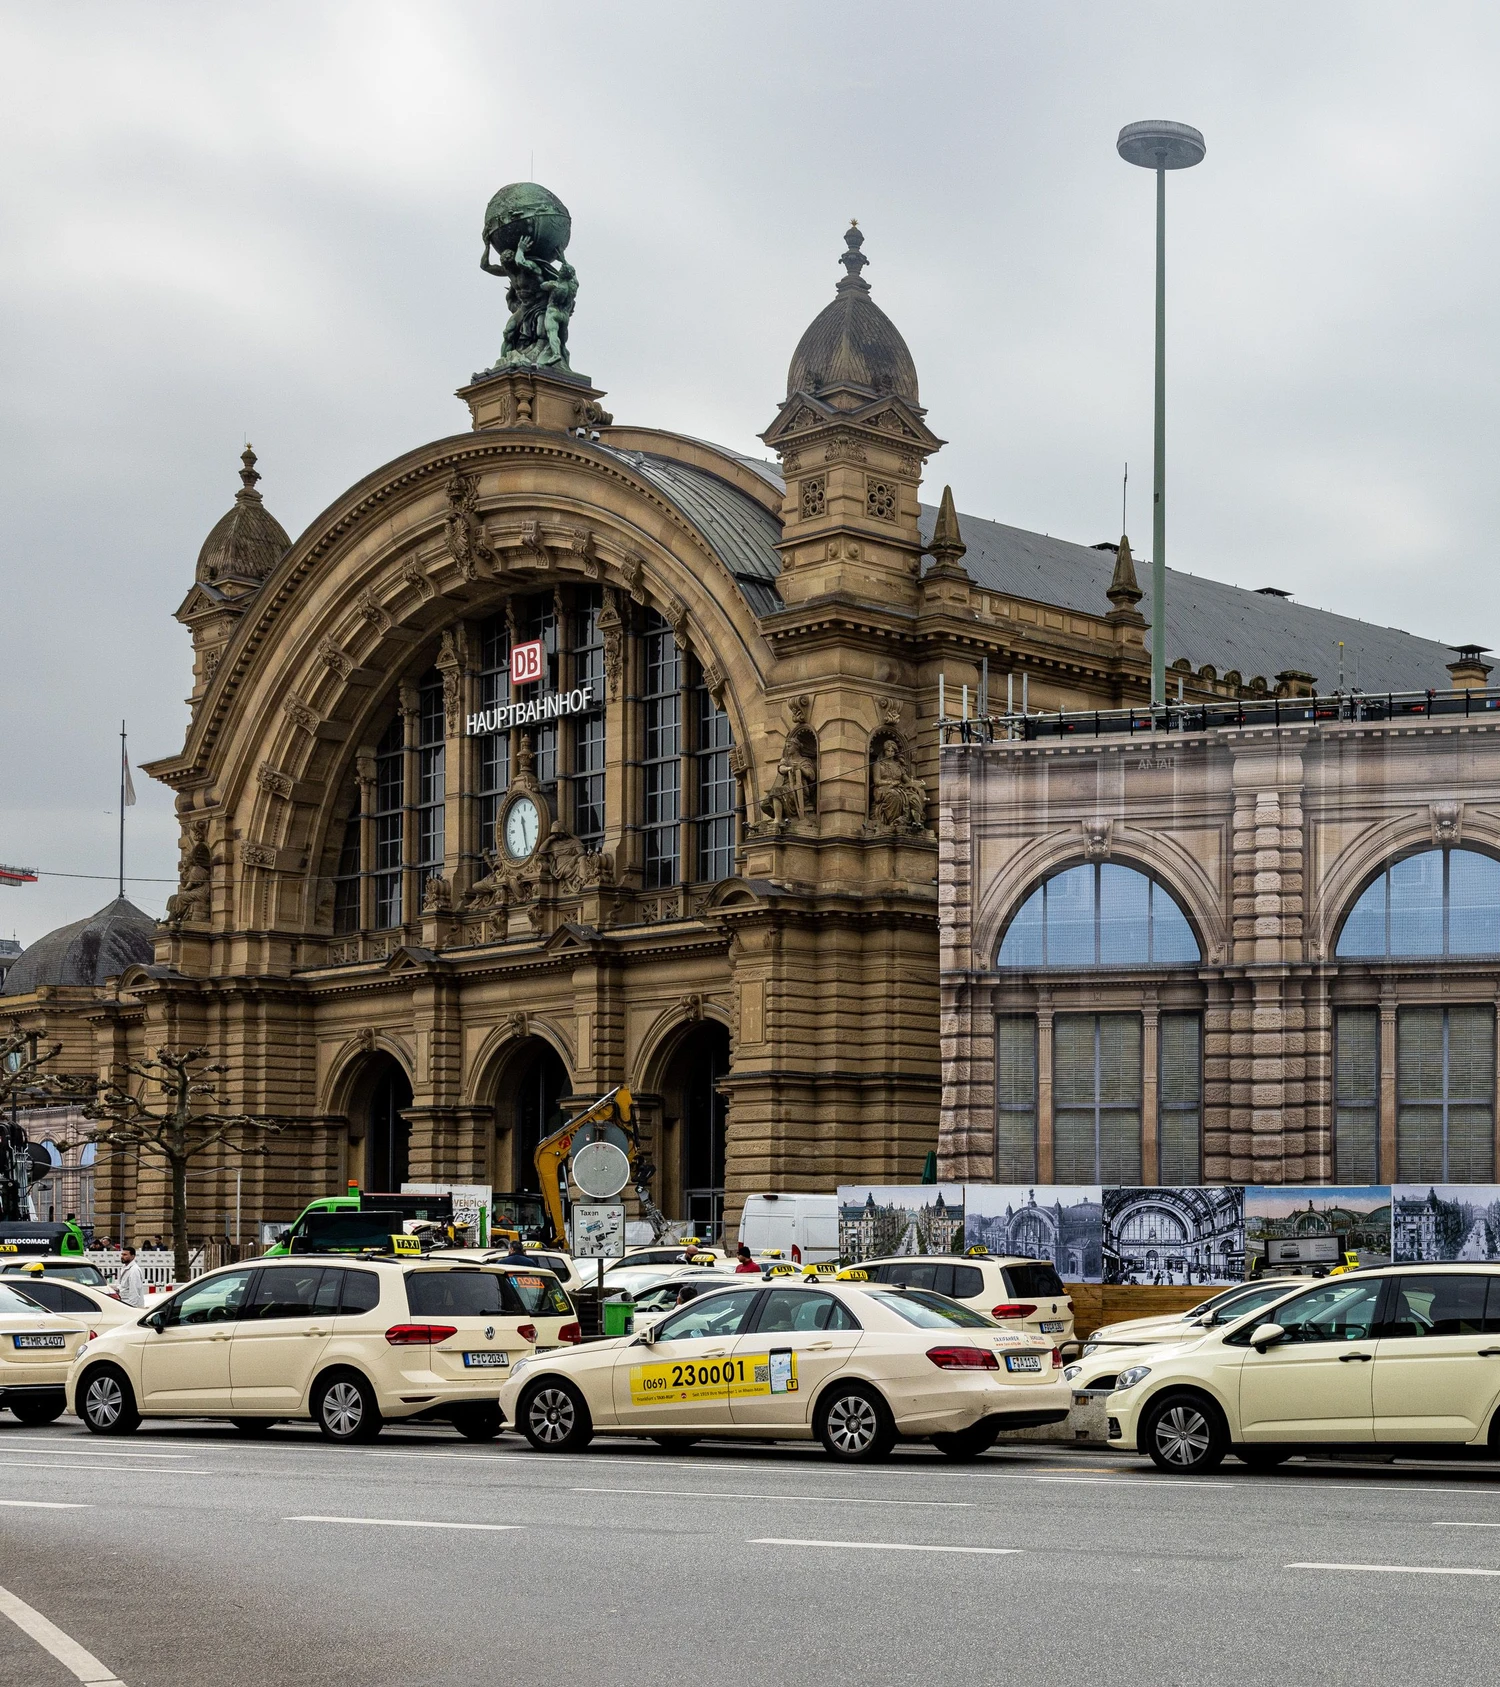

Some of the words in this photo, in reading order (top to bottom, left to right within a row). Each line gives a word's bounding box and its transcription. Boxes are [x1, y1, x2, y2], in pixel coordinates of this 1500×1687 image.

[514, 647, 538, 678] DB
[466, 686, 594, 735] HAUPTBAHNHOF
[398, 1240, 420, 1249] TAXI
[819, 1265, 837, 1273] TAXI
[472, 1354, 477, 1364] F
[488, 1353, 505, 1363] 2031
[643, 1378, 667, 1391] (069)
